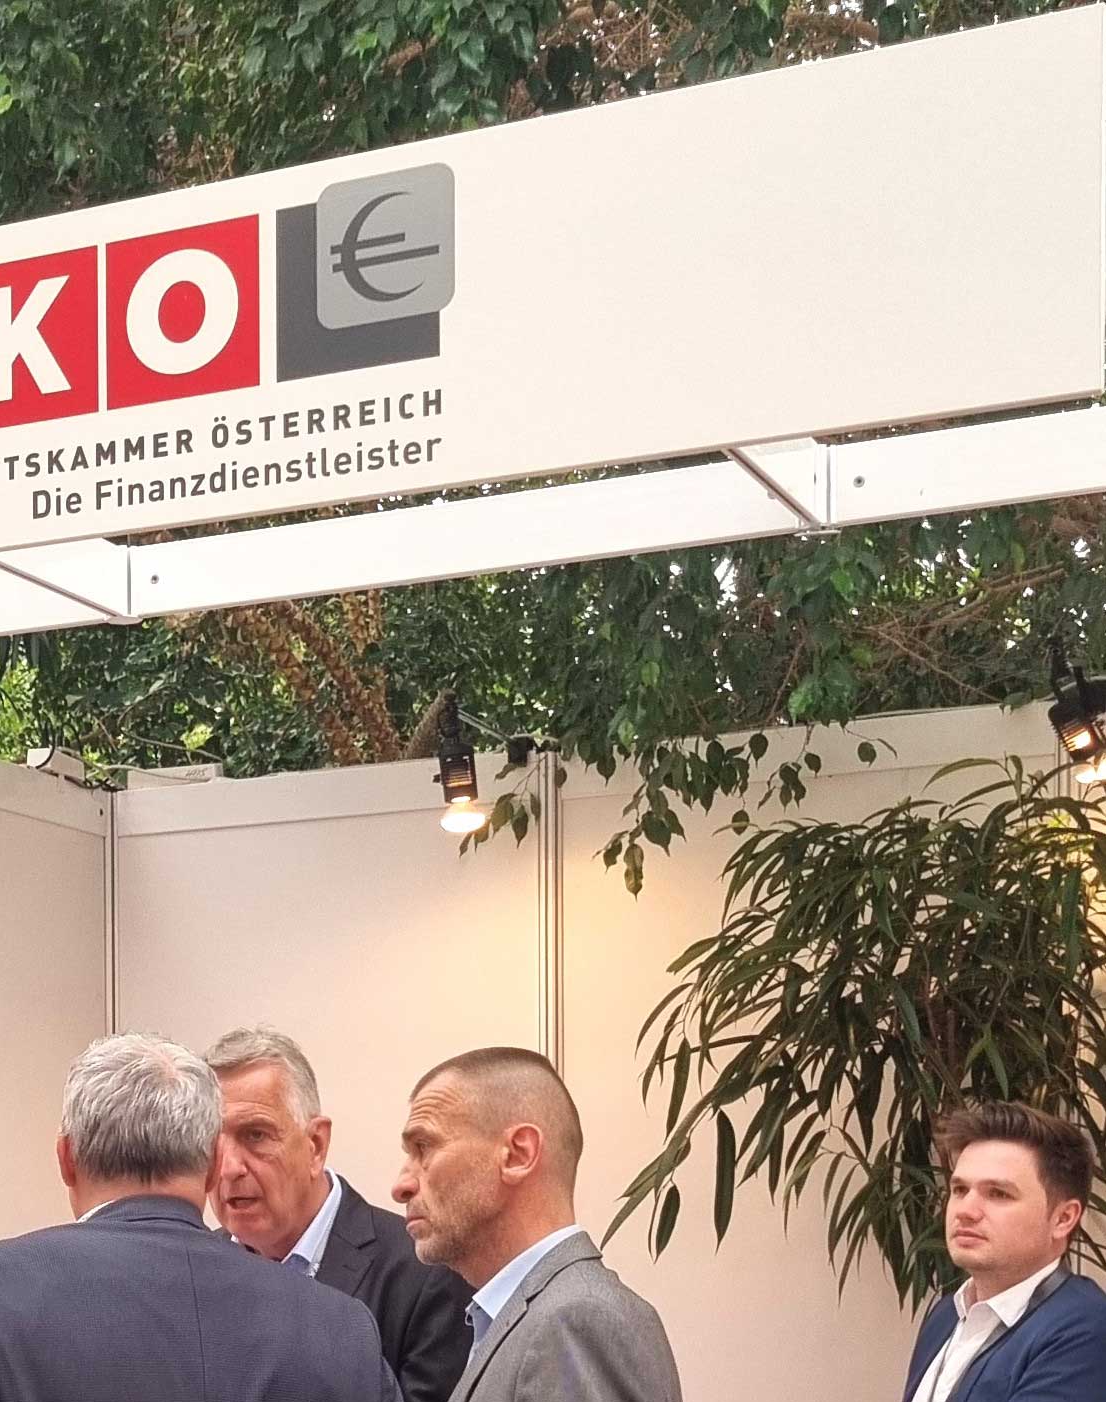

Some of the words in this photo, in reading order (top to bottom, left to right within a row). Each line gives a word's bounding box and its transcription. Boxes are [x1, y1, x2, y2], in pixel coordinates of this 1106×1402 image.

[211, 388, 443, 450] ÖSTERREICH
[32, 488, 82, 520] Die
[95, 437, 442, 511] Finanzdienstleister
